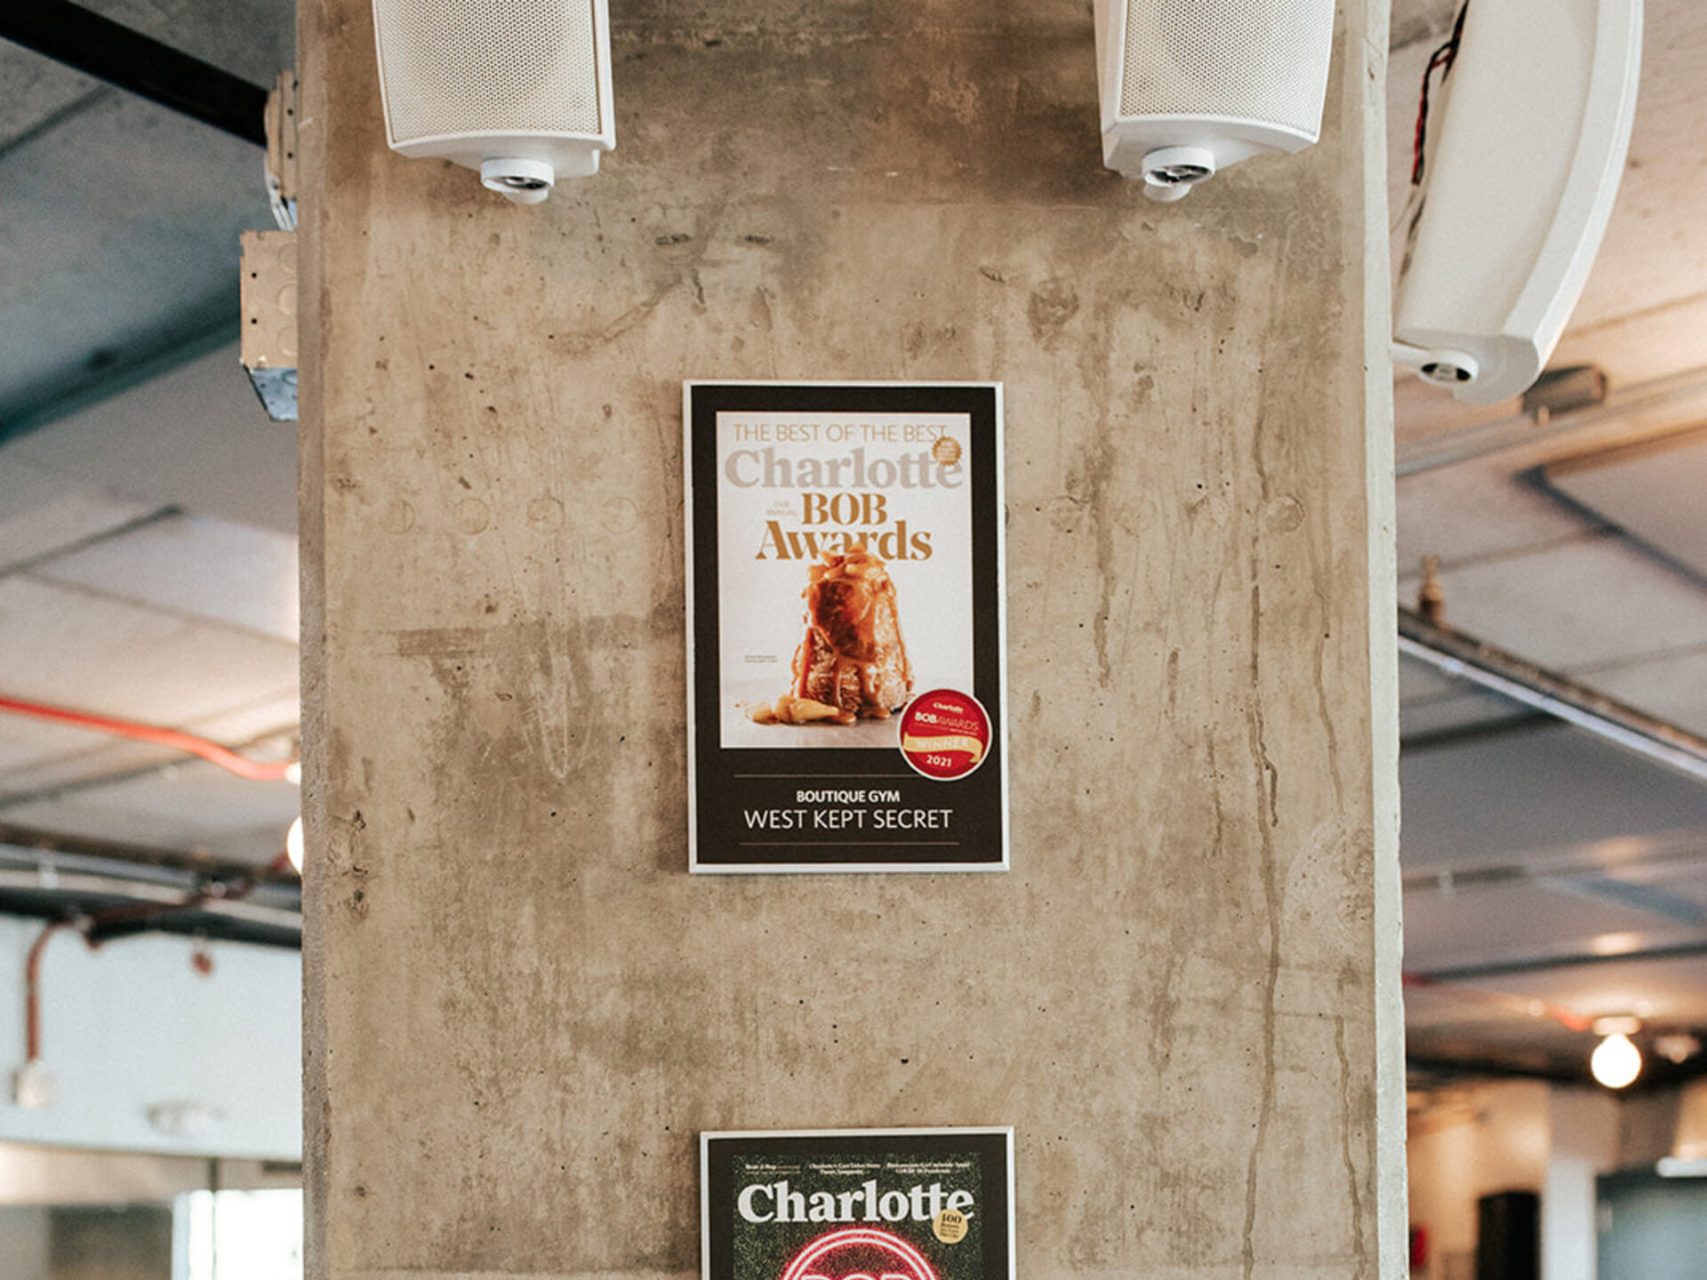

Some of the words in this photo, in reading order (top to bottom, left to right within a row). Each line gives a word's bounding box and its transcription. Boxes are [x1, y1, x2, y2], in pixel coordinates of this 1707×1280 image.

[733, 424, 770, 441] THE
[776, 424, 821, 441] BEST
[826, 424, 855, 441] OF
[861, 424, 901, 442] THE
[904, 424, 948, 442] BEST
[724, 447, 963, 489] Charlotte
[801, 493, 888, 525] BOB
[756, 520, 933, 561] Awards
[926, 754, 952, 767] 2021
[796, 790, 867, 803] BOUTIQUE
[868, 790, 900, 803] GYM
[744, 810, 808, 829] WEST
[814, 810, 867, 829] KEPT
[873, 810, 953, 829] SECRET
[737, 1179, 976, 1223] Charlotte
